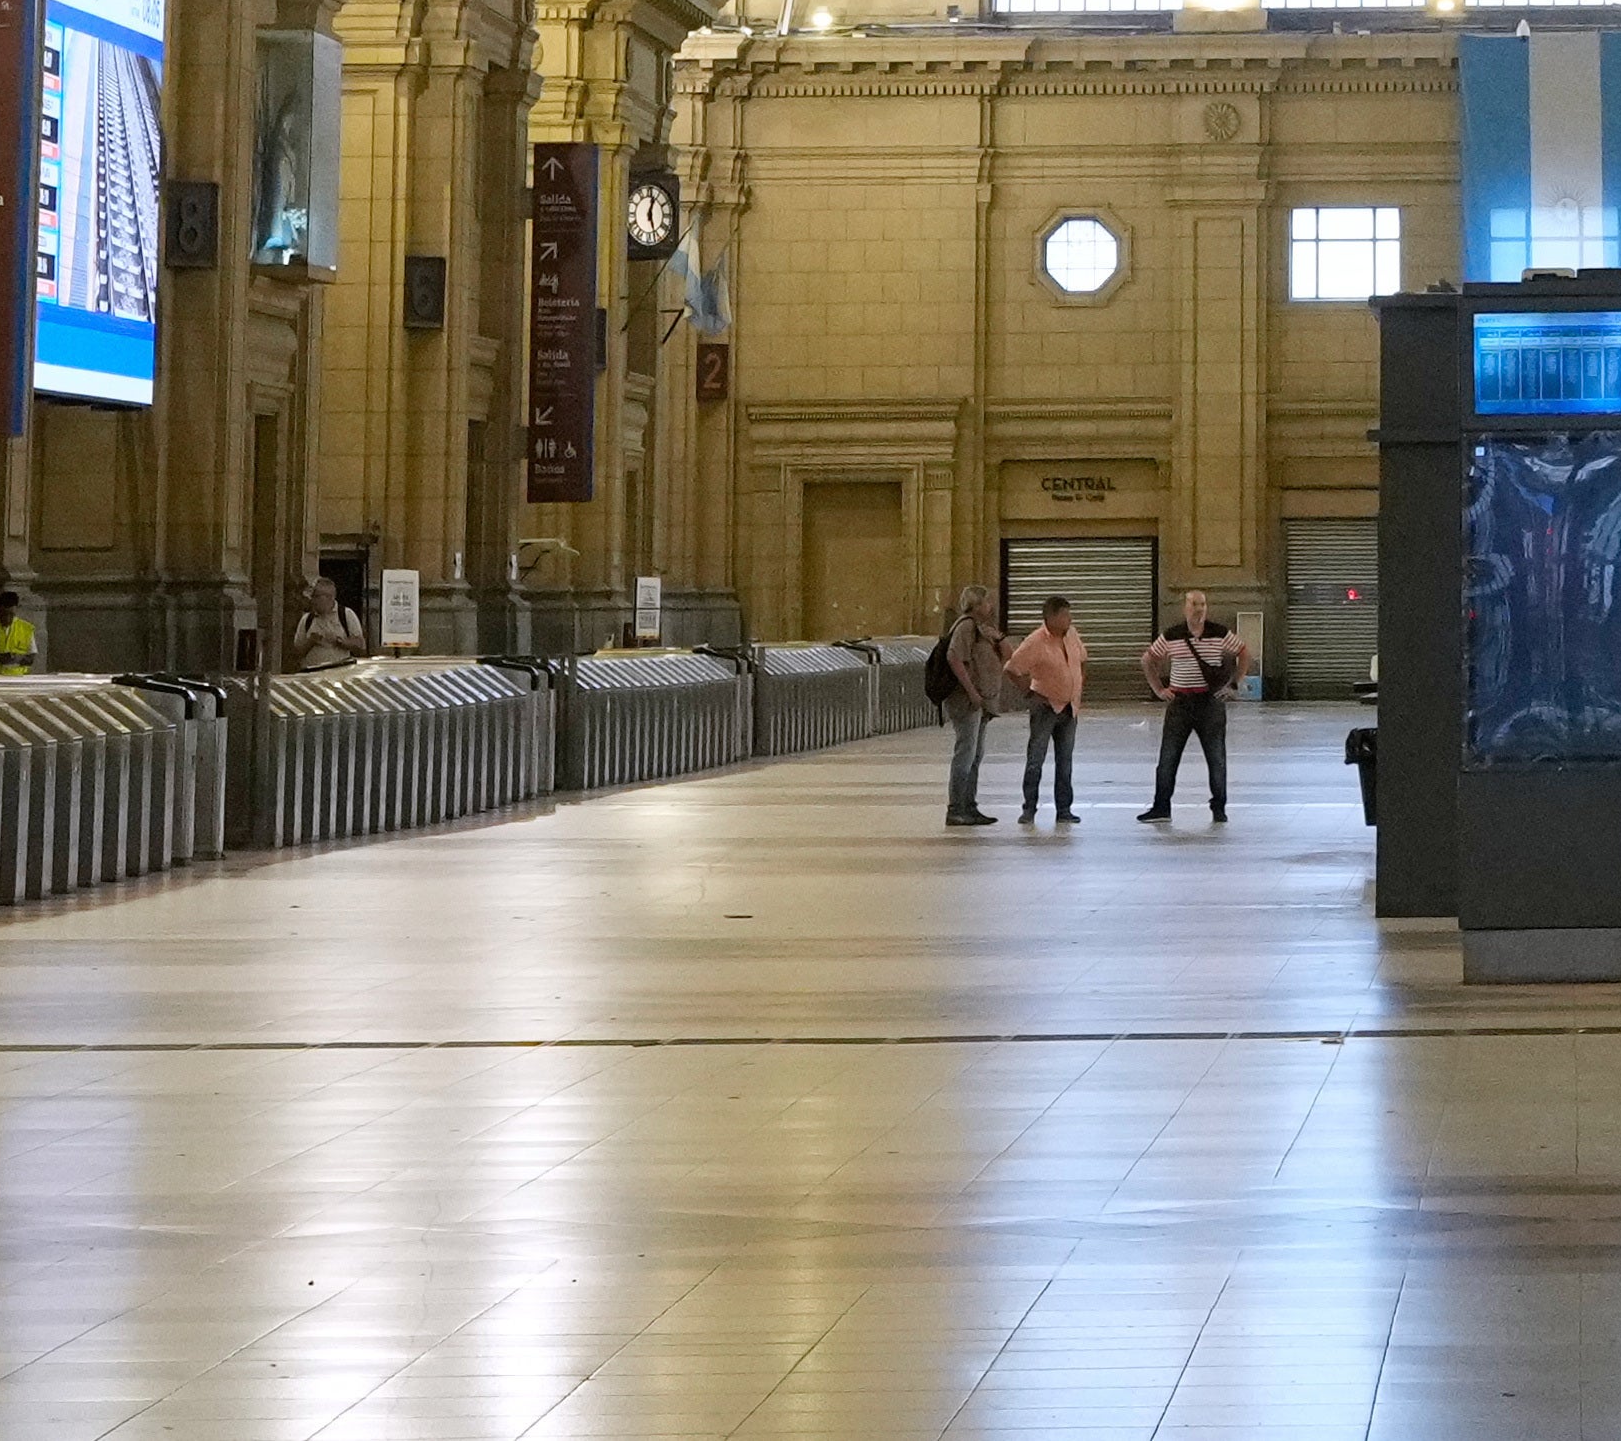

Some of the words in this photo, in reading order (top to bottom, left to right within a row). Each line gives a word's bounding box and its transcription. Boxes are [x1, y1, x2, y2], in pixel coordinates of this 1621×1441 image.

[539, 194, 571, 205] Salida
[703, 352, 722, 389] 2
[1041, 477, 1116, 491] CENTRAL
